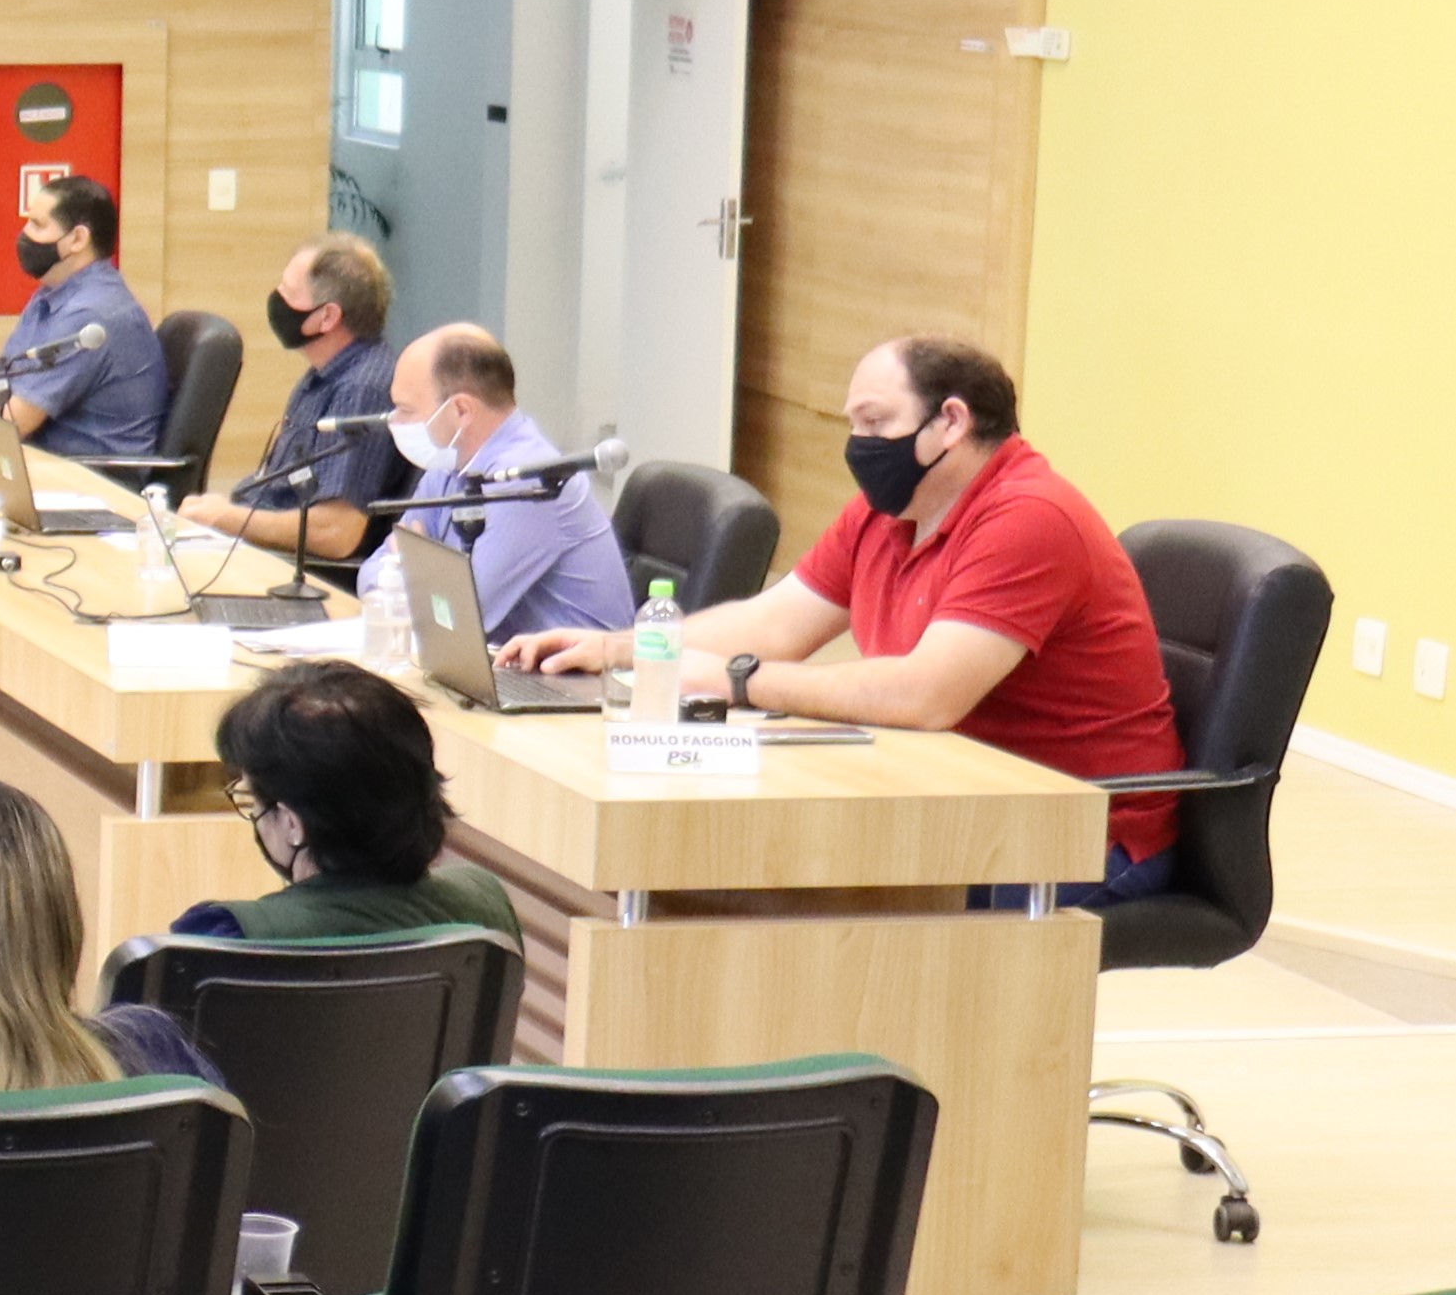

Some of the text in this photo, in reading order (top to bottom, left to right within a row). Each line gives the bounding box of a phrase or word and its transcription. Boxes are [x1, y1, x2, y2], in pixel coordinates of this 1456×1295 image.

[610, 734, 753, 748] ROMULO FAGGION
[666, 750, 703, 765] PSL
